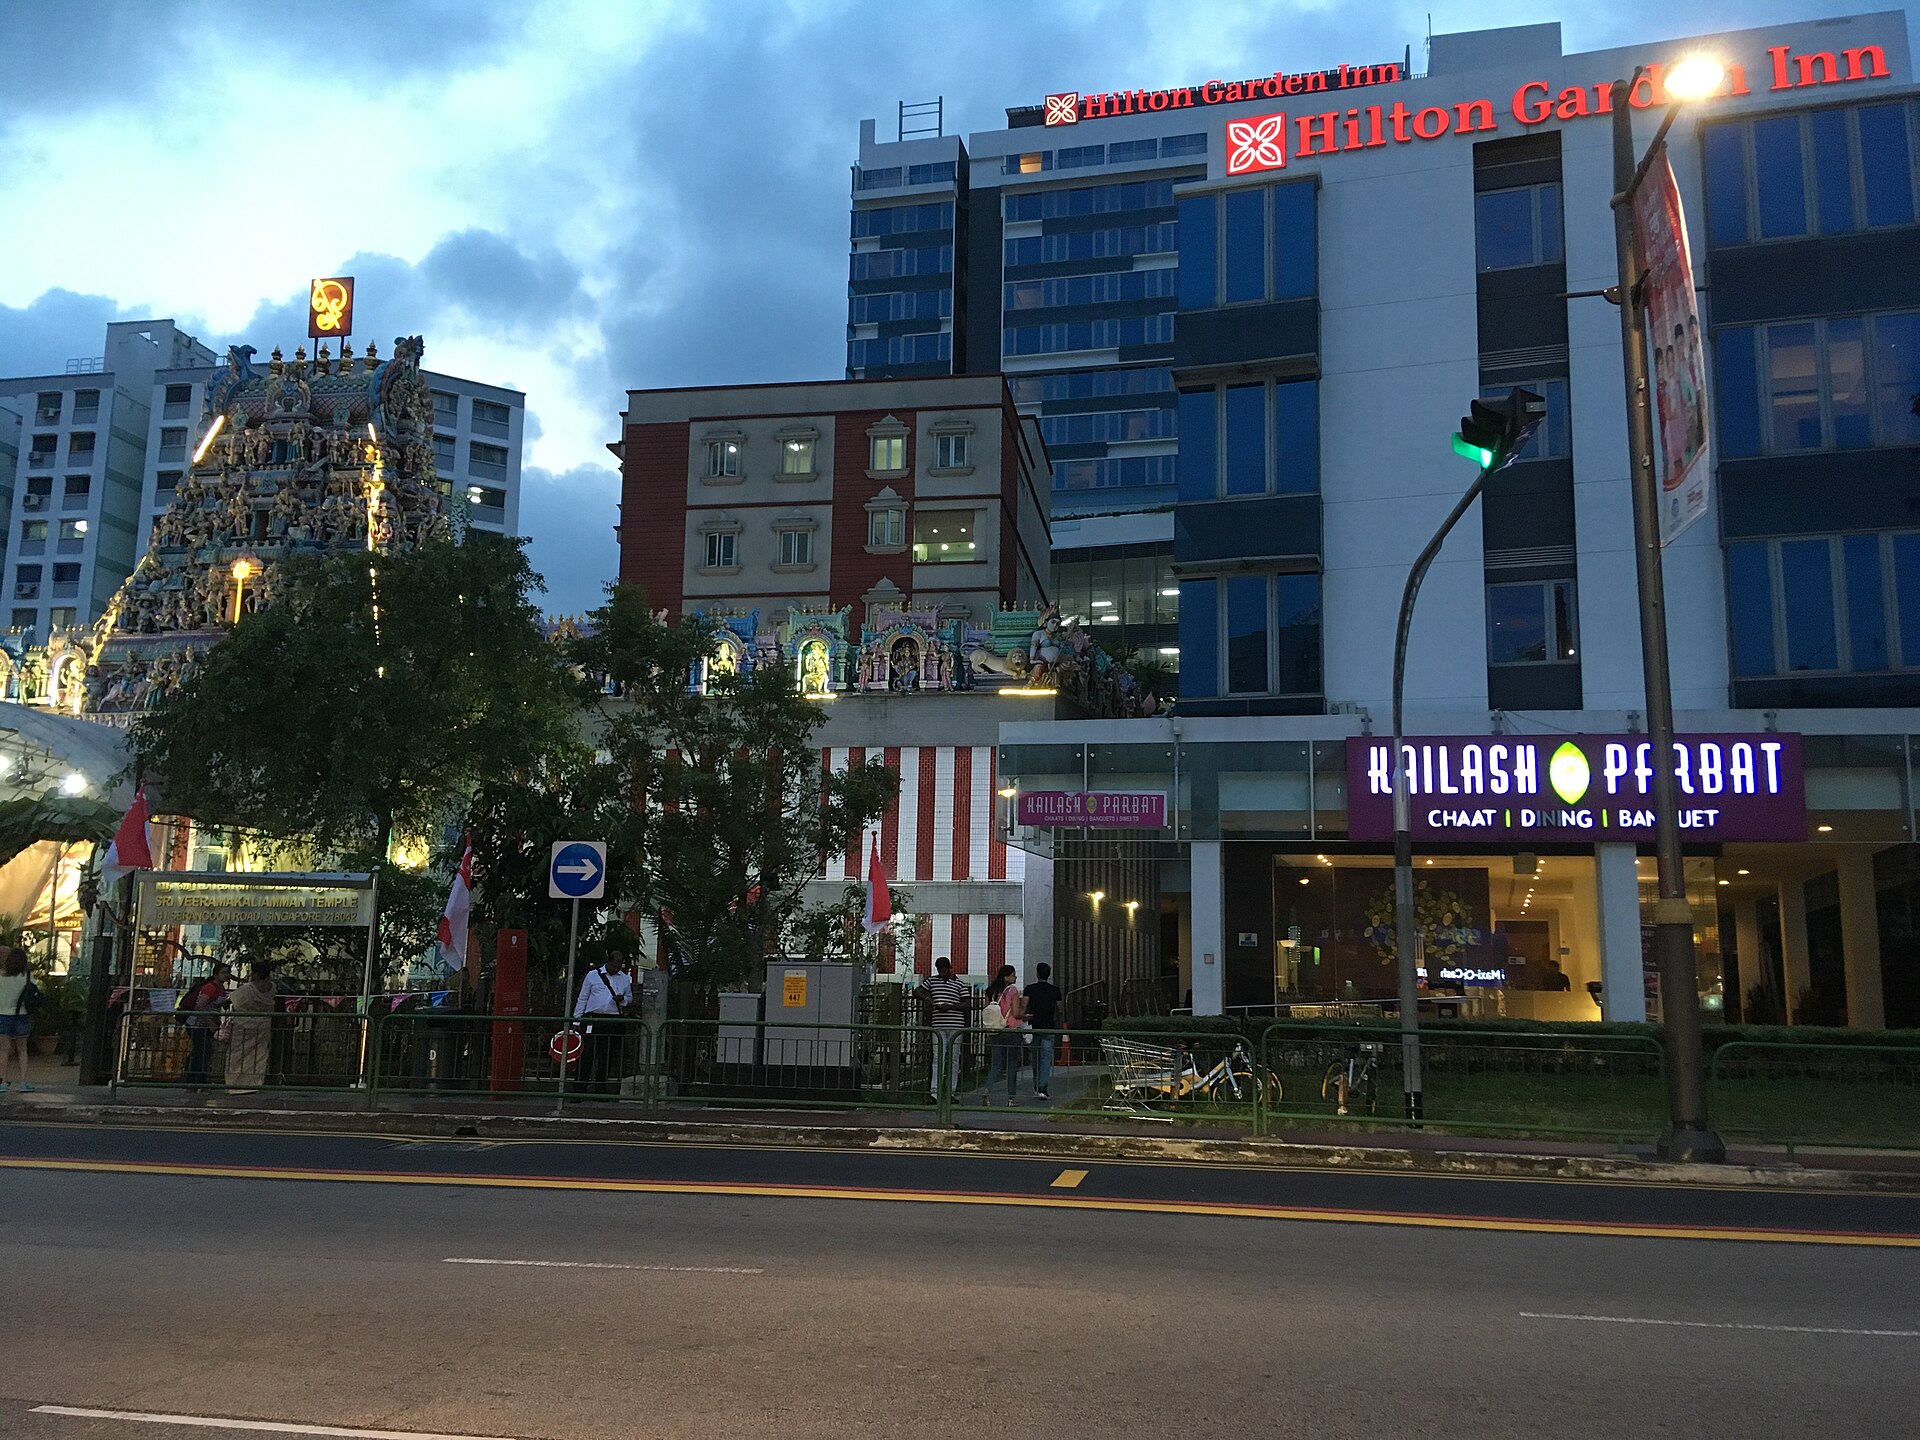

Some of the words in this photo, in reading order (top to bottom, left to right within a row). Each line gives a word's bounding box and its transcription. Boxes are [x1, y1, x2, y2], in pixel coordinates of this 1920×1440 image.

[1083, 87, 1194, 119] Hilton
[1202, 72, 1328, 104] Garden
[1338, 63, 1401, 88] Inn
[1296, 99, 1497, 157] Hilton
[1512, 64, 1750, 125] Gardn
[1767, 45, 1891, 91] Inn
[1368, 744, 1537, 794] KAILASH
[1026, 796, 1081, 813] KAILASH
[1103, 796, 1158, 813] PARBAT
[1428, 809, 1497, 827] CHAAT
[1521, 810, 1593, 828] DINING
[1619, 809, 1719, 828] BANUET
[155, 896, 174, 907] SRI
[179, 896, 306, 908] VEERAMAKALIAMMAN
[310, 897, 359, 908] TEMPLE
[171, 911, 232, 921] SERANGOON
[266, 911, 321, 922] SINGAPORE
[324, 911, 358, 922] 218042
